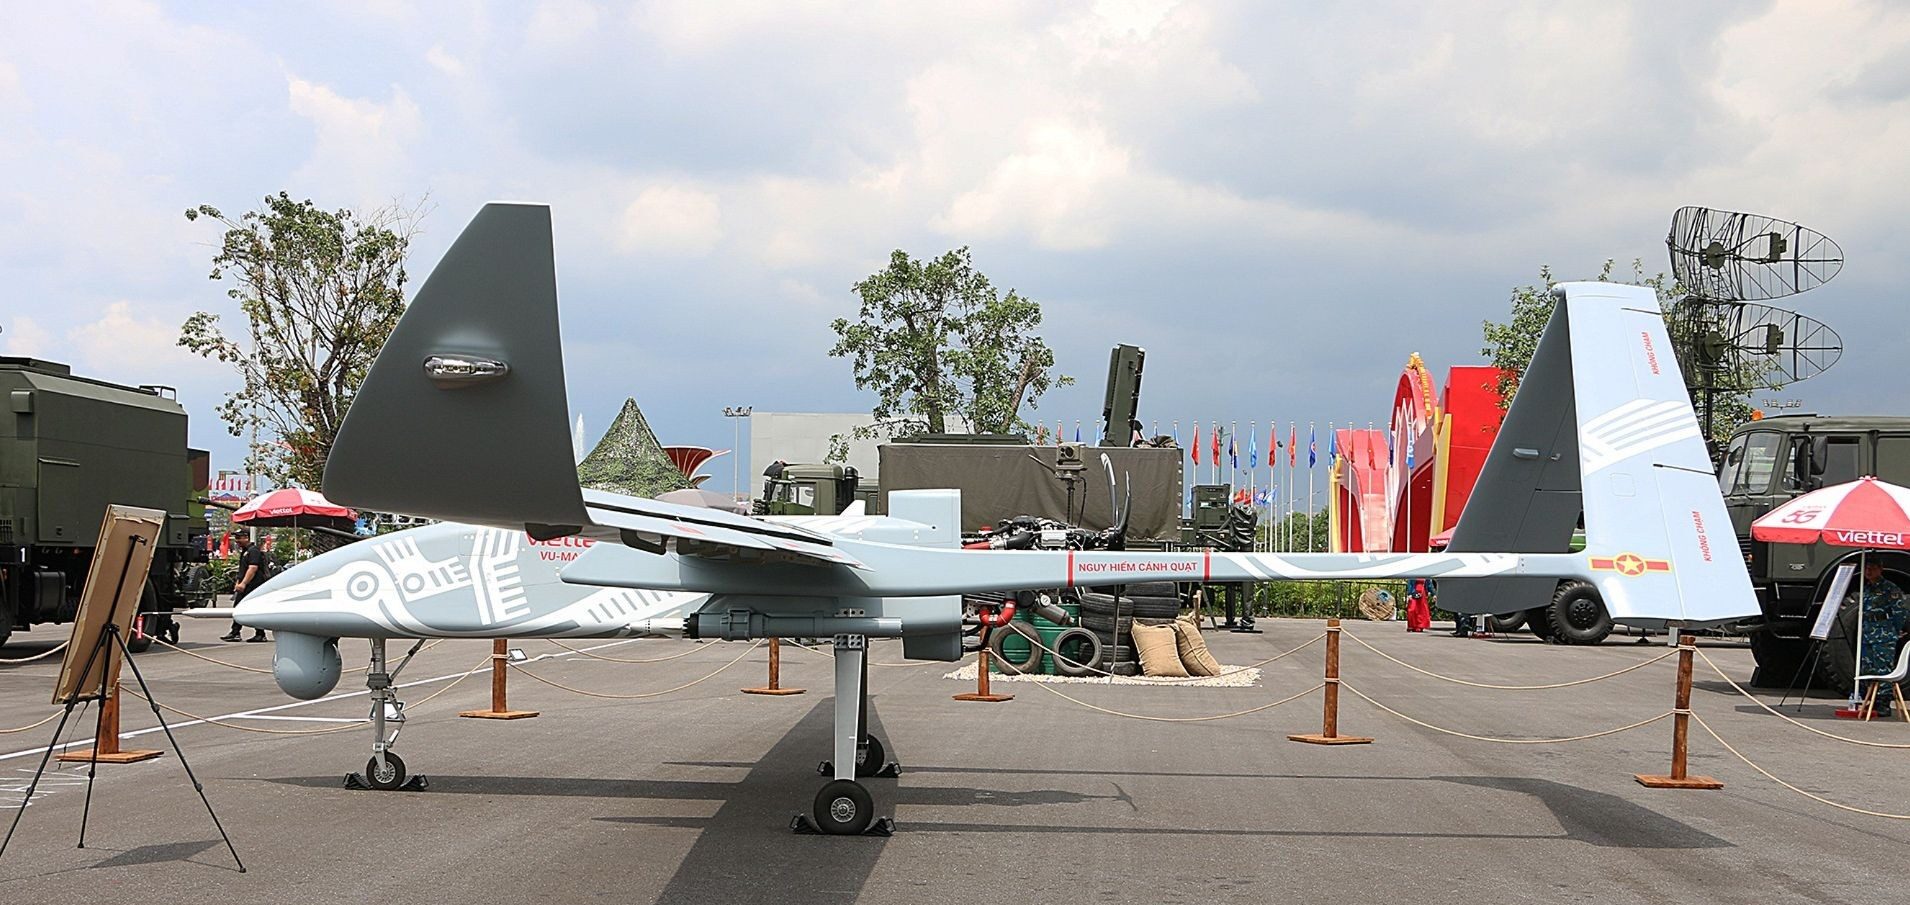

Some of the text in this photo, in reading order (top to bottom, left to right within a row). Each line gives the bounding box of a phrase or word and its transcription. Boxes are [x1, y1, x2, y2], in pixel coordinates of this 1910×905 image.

[1782, 510, 1821, 524] 5G
[1836, 530, 1904, 545] viettel
[20, 547, 26, 562] 1
[1698, 534, 1712, 562] KHÔNG
[540, 551, 578, 561] VU-MA
[1079, 563, 1106, 572] NGUY
[1138, 561, 1168, 571] CÁNH
[1170, 562, 1197, 573] QUẠT
